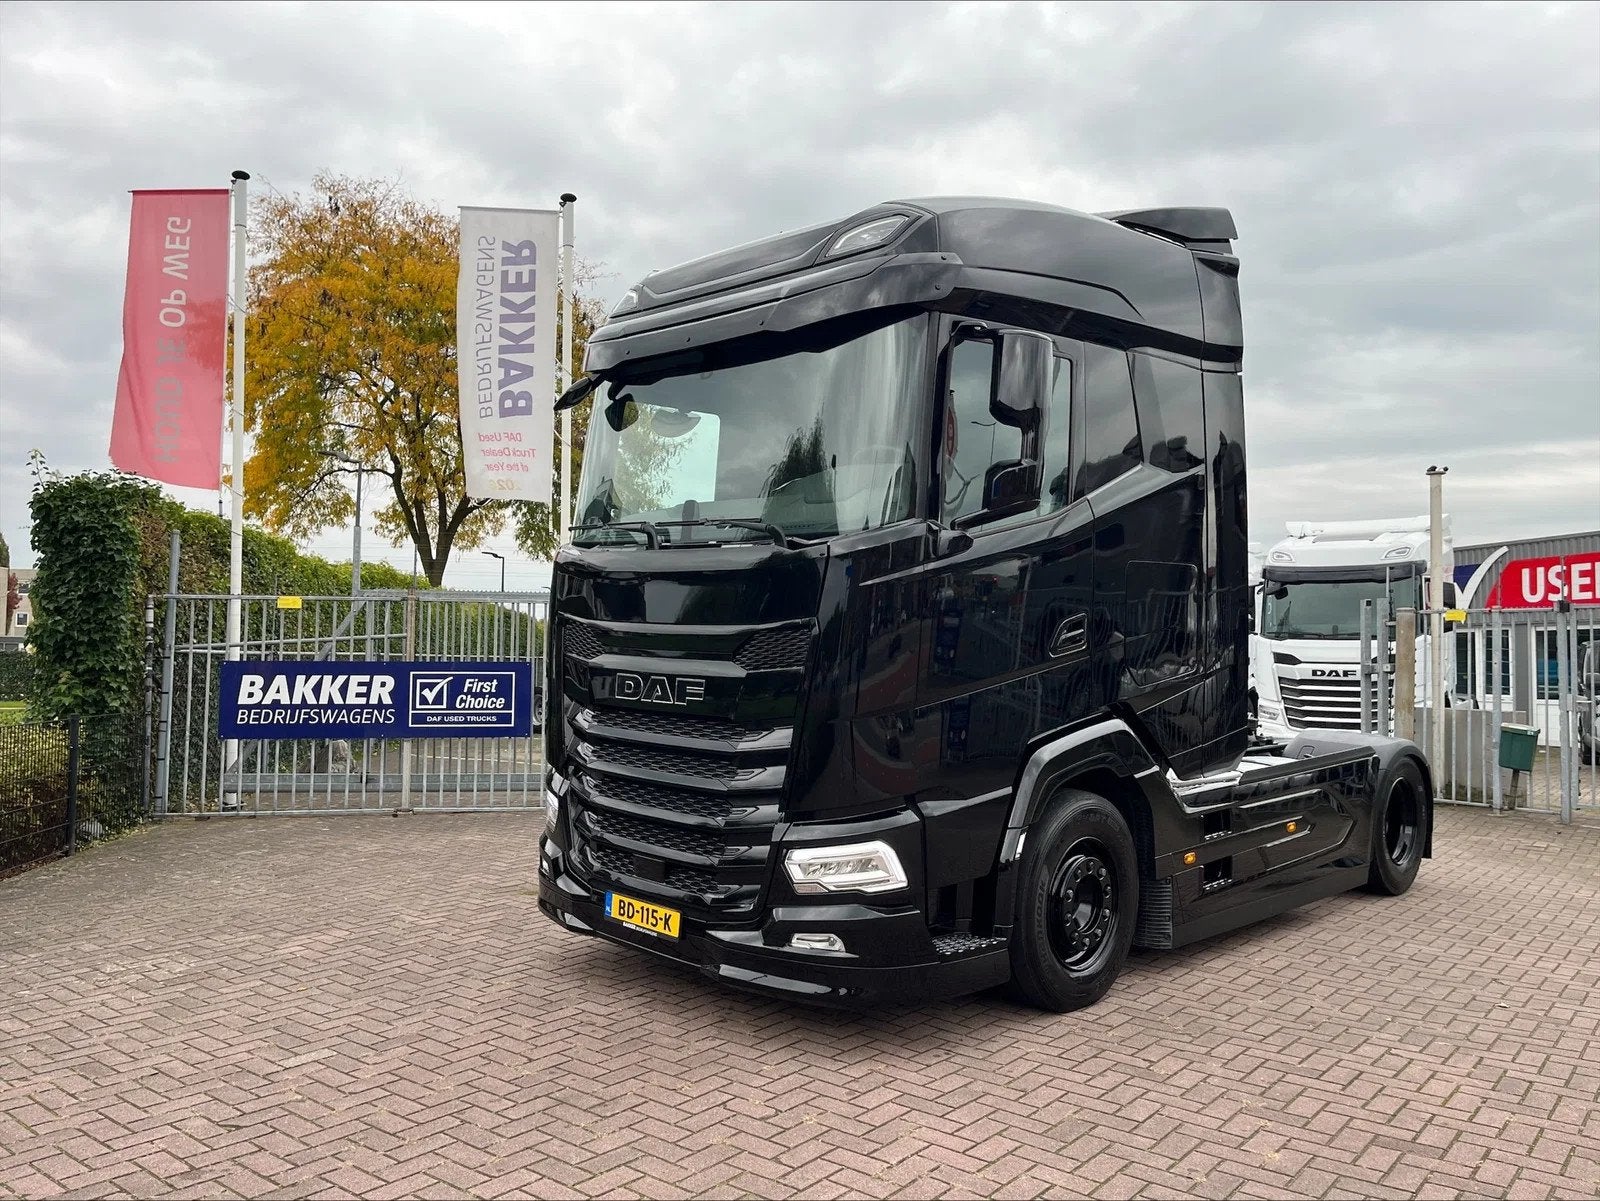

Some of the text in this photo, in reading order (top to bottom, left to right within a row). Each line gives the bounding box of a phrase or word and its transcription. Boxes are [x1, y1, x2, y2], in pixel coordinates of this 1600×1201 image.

[1521, 560, 1600, 604] USE
[463, 678, 499, 693] First
[1311, 669, 1357, 678] DAF
[236, 674, 396, 705] BAKKER
[615, 672, 706, 706] DAF
[455, 694, 506, 709] Choice
[236, 708, 396, 725] BEDRIJFSWAGENS
[618, 898, 672, 933] BD-115-K
